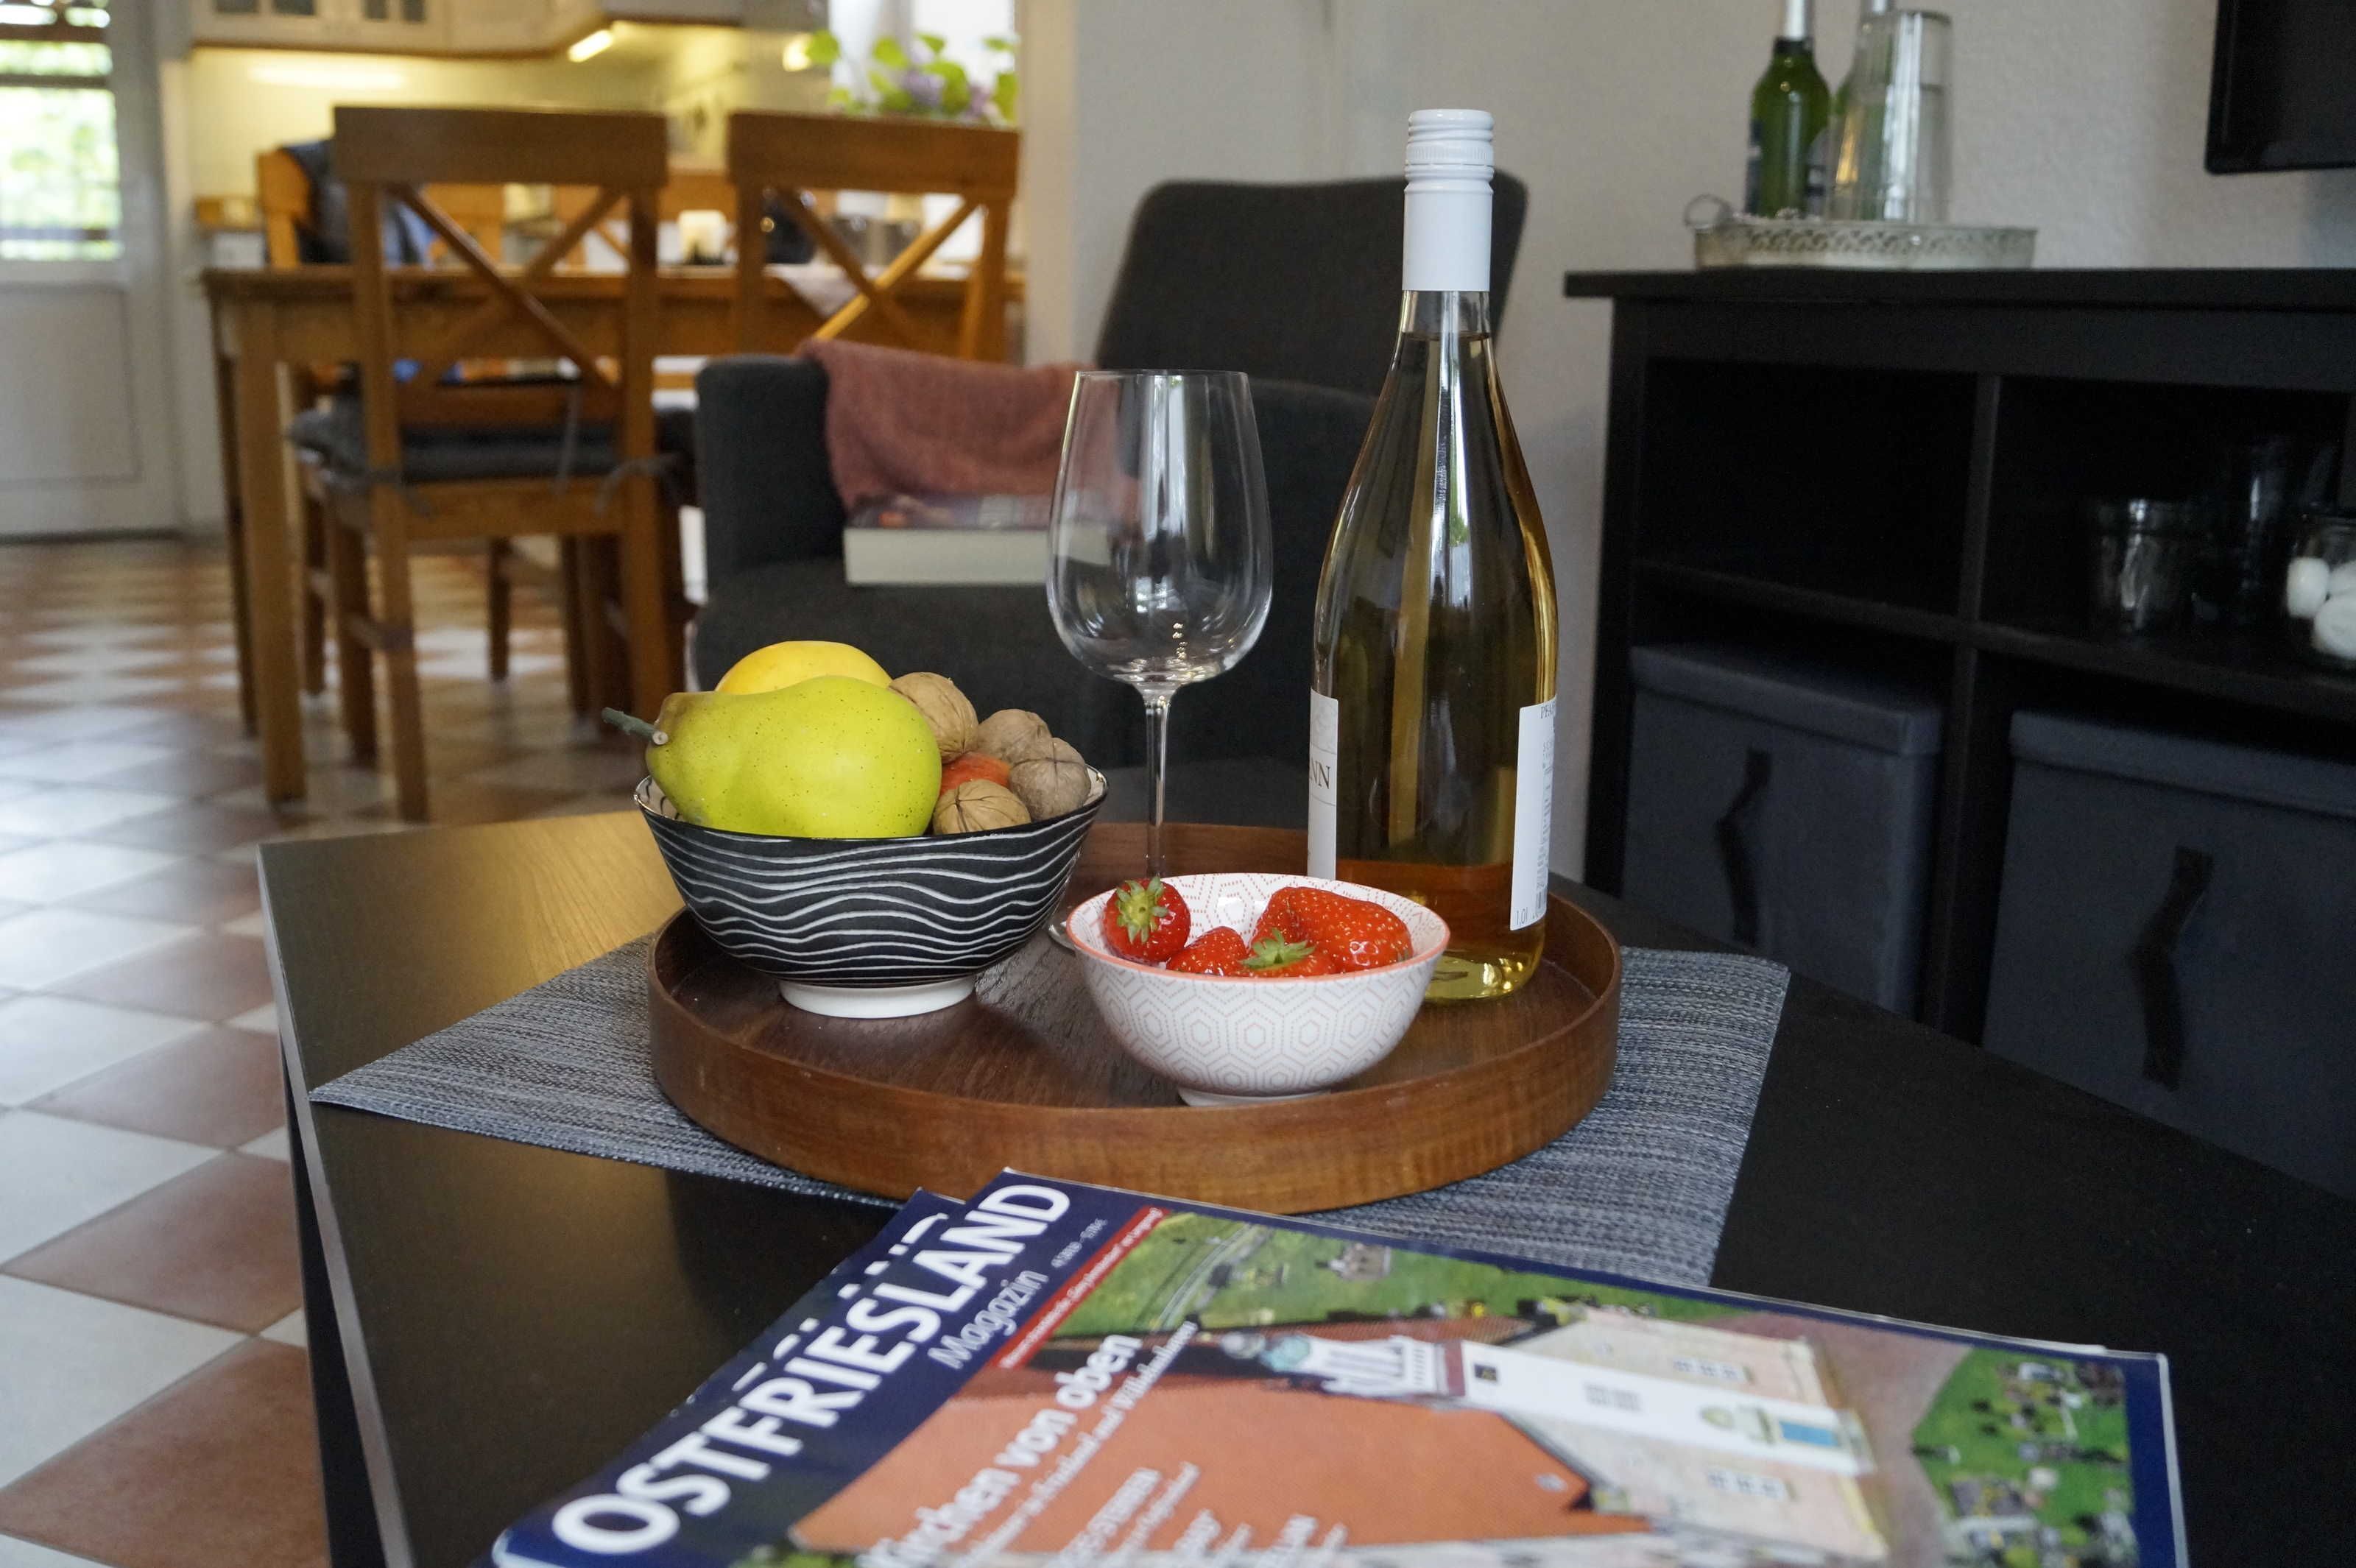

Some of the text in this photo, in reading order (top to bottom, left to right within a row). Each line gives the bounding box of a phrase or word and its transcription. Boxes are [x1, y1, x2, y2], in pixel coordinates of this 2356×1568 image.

[552, 1184, 1071, 1555] OSTFRIESLAND
[927, 1270, 1049, 1370] Magazin
[994, 1408, 1077, 1467] von
[1054, 1334, 1143, 1409] oben
